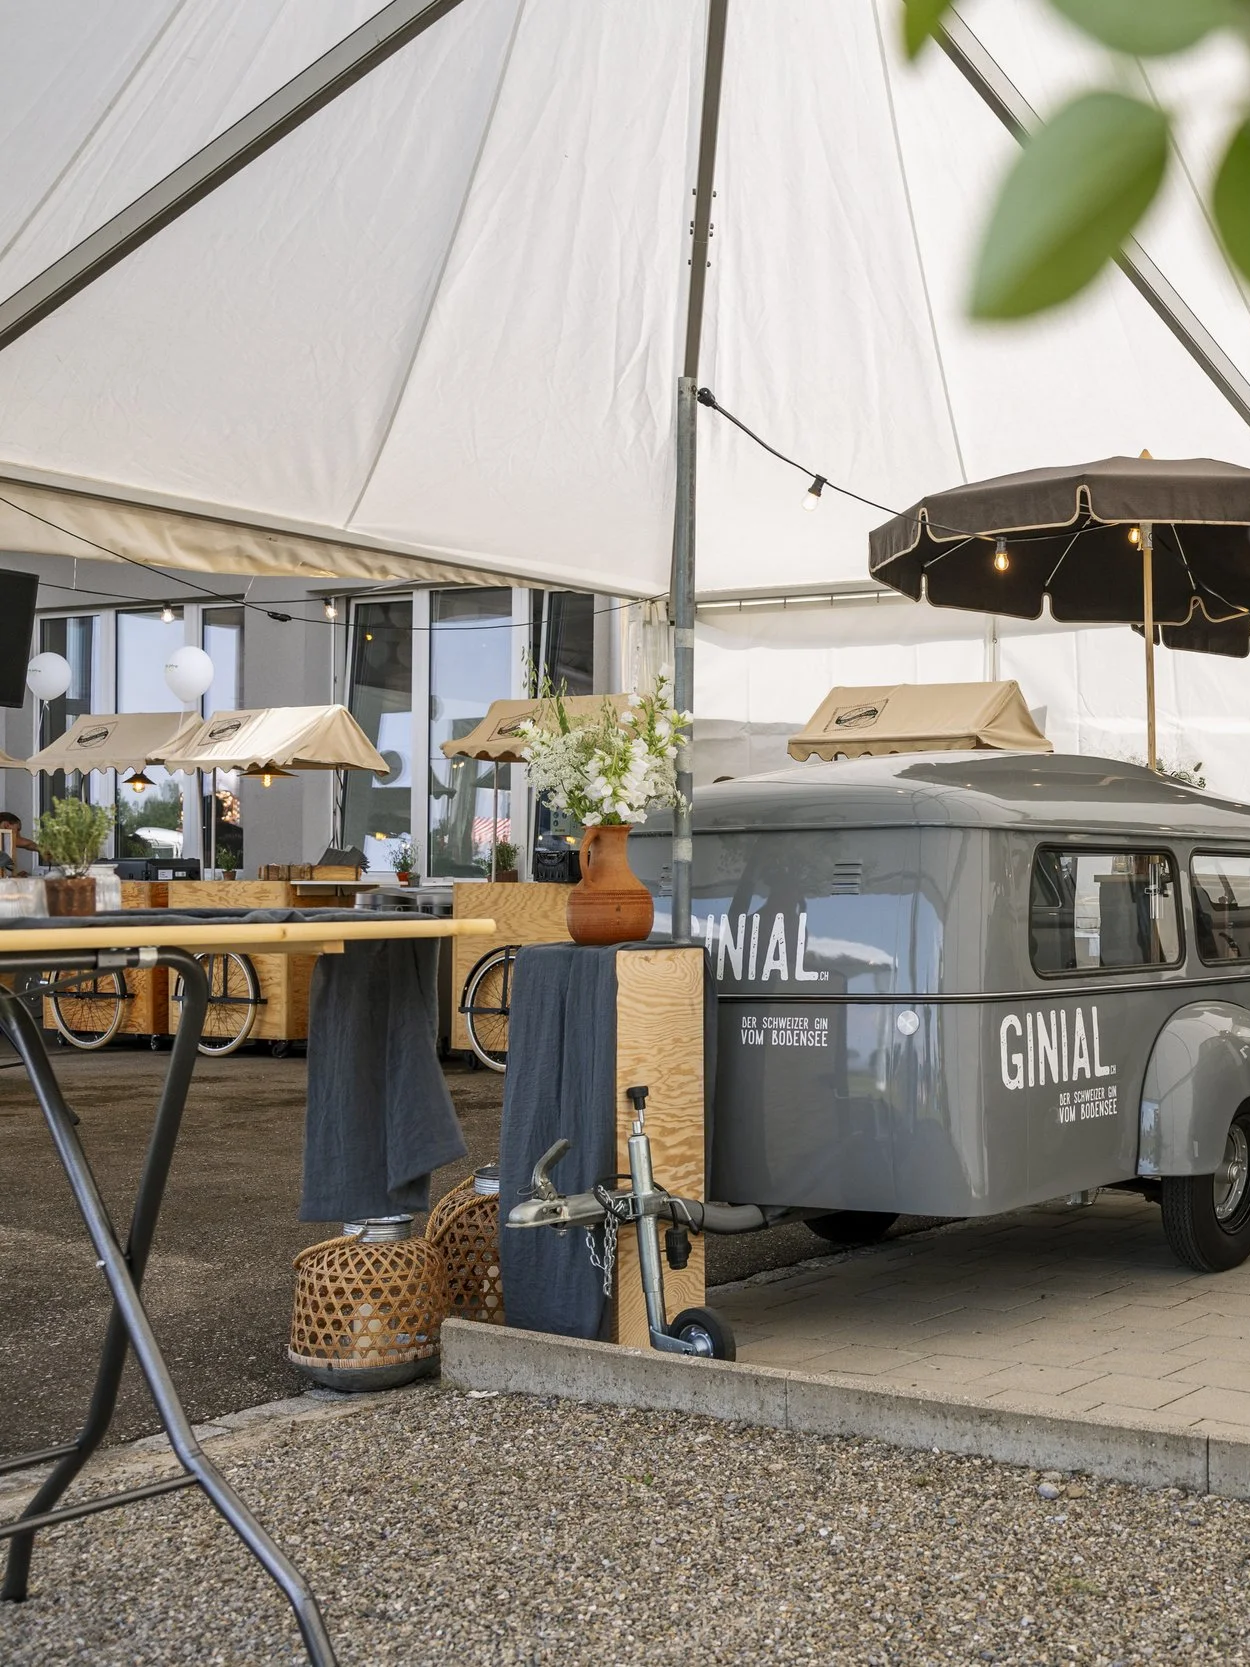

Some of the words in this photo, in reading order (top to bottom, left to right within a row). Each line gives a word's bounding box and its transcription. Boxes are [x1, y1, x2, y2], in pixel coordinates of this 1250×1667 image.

[742, 1016, 757, 1028] DER
[762, 1016, 809, 1030] SCHWEIZER
[814, 1017, 829, 1030] GIN
[741, 1029, 764, 1045] VOM
[771, 1030, 829, 1047] BODENSEE
[1059, 1092, 1071, 1106] DER
[1073, 1087, 1106, 1104] SCHWEIZER
[1107, 1085, 1118, 1098] GIN
[1059, 1105, 1076, 1124] VOM
[1080, 1098, 1118, 1120] BODENSEE
